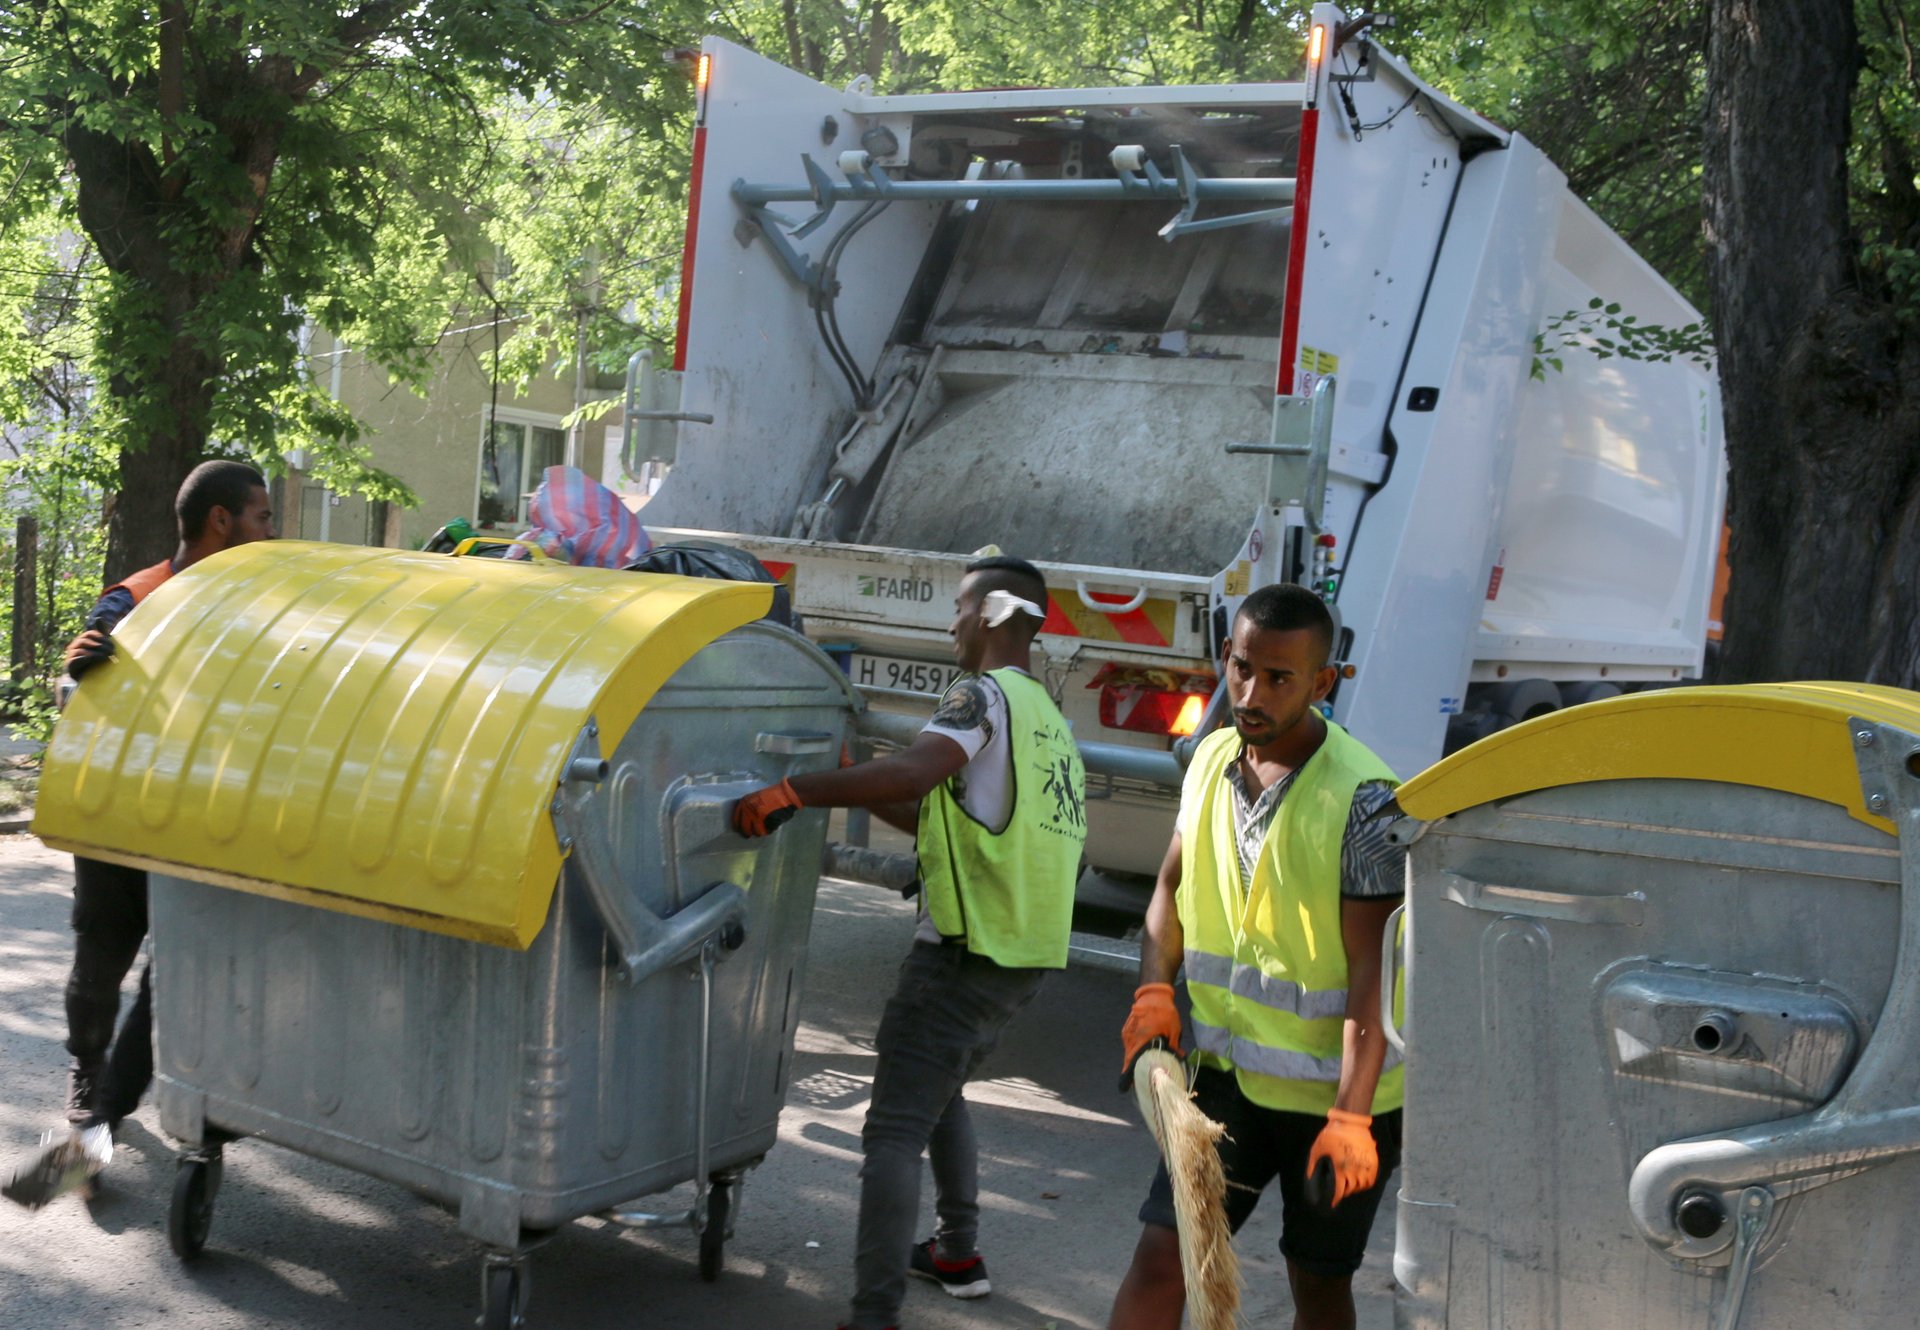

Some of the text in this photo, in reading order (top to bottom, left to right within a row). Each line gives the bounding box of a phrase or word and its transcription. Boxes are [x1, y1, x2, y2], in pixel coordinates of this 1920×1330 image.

[877, 577, 934, 602] FARID
[860, 659, 876, 685] H
[887, 662, 942, 693] 9459
